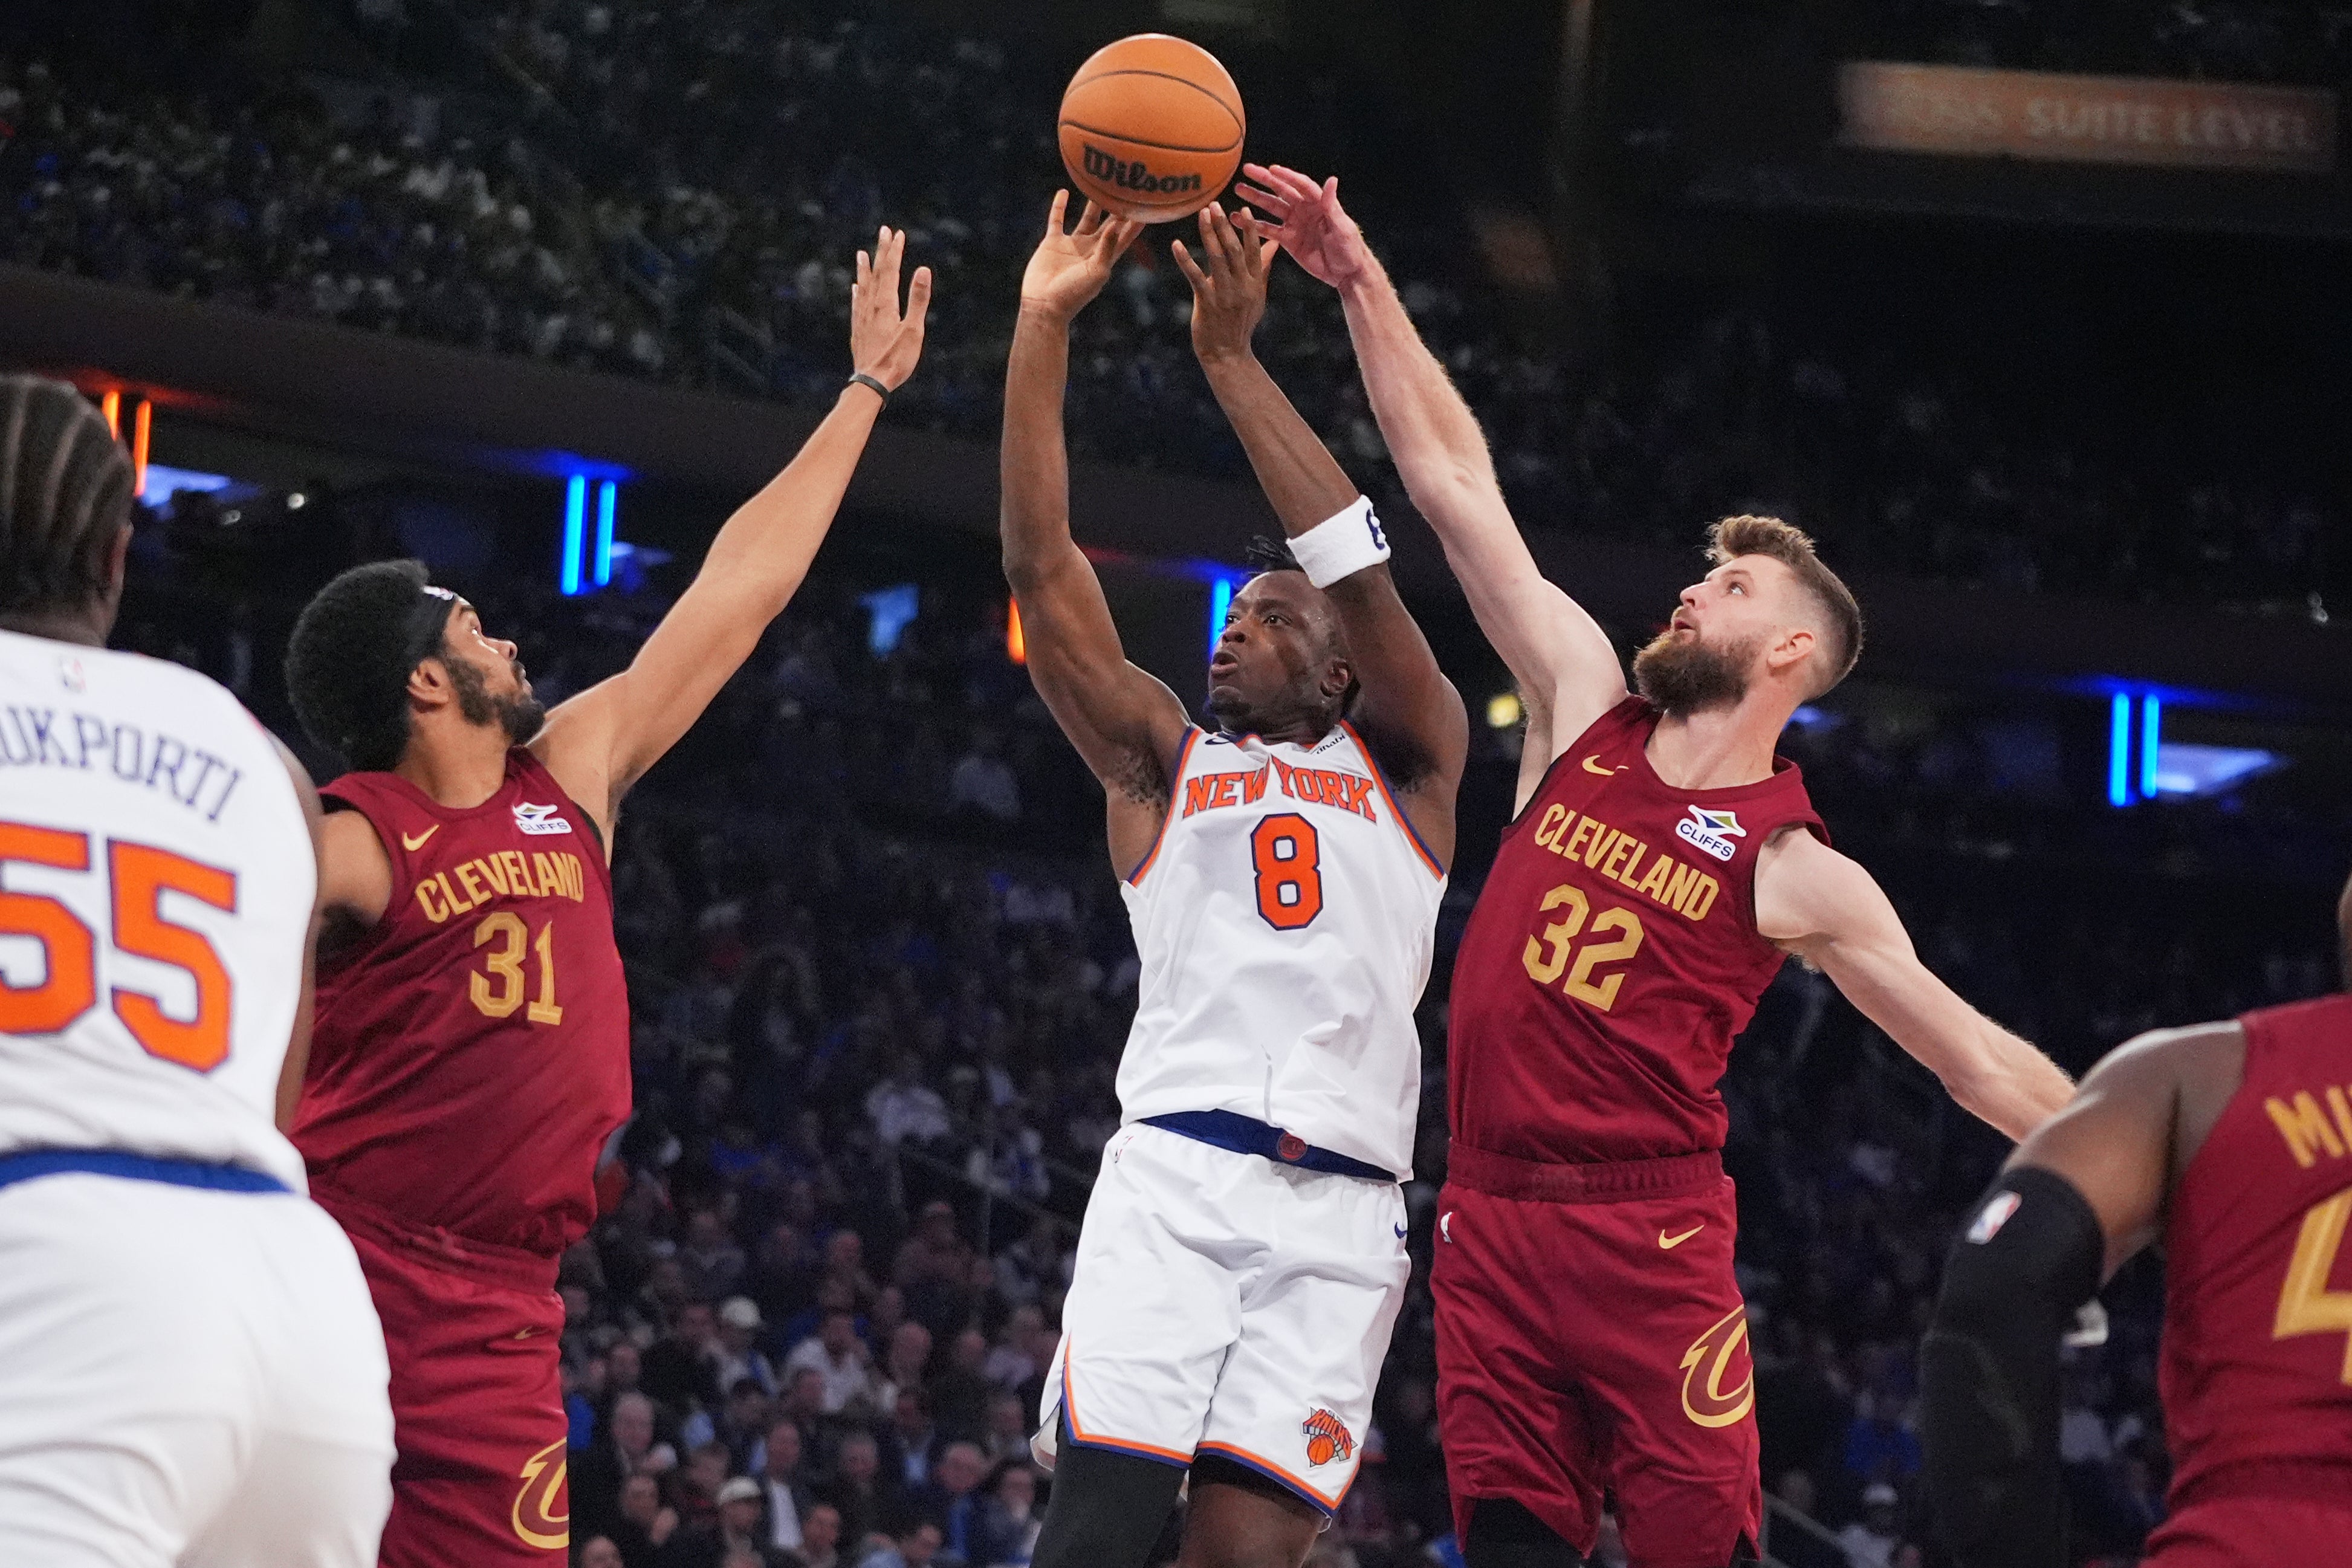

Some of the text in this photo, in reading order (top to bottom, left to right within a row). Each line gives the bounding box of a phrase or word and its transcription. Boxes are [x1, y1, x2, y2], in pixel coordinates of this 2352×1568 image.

[1083, 143, 1202, 193] Wilson
[520, 822, 568, 832] CLIFFS
[1182, 756, 1376, 823] NEW YORK
[415, 850, 584, 923] CLEVELAND
[1251, 813, 1323, 931] 8
[1534, 803, 1719, 921] CLEVELAND
[1680, 823, 1732, 857] CLIFFS
[0, 821, 239, 1075] 55
[470, 912, 563, 1025] 31
[1523, 884, 1644, 1012] 32
